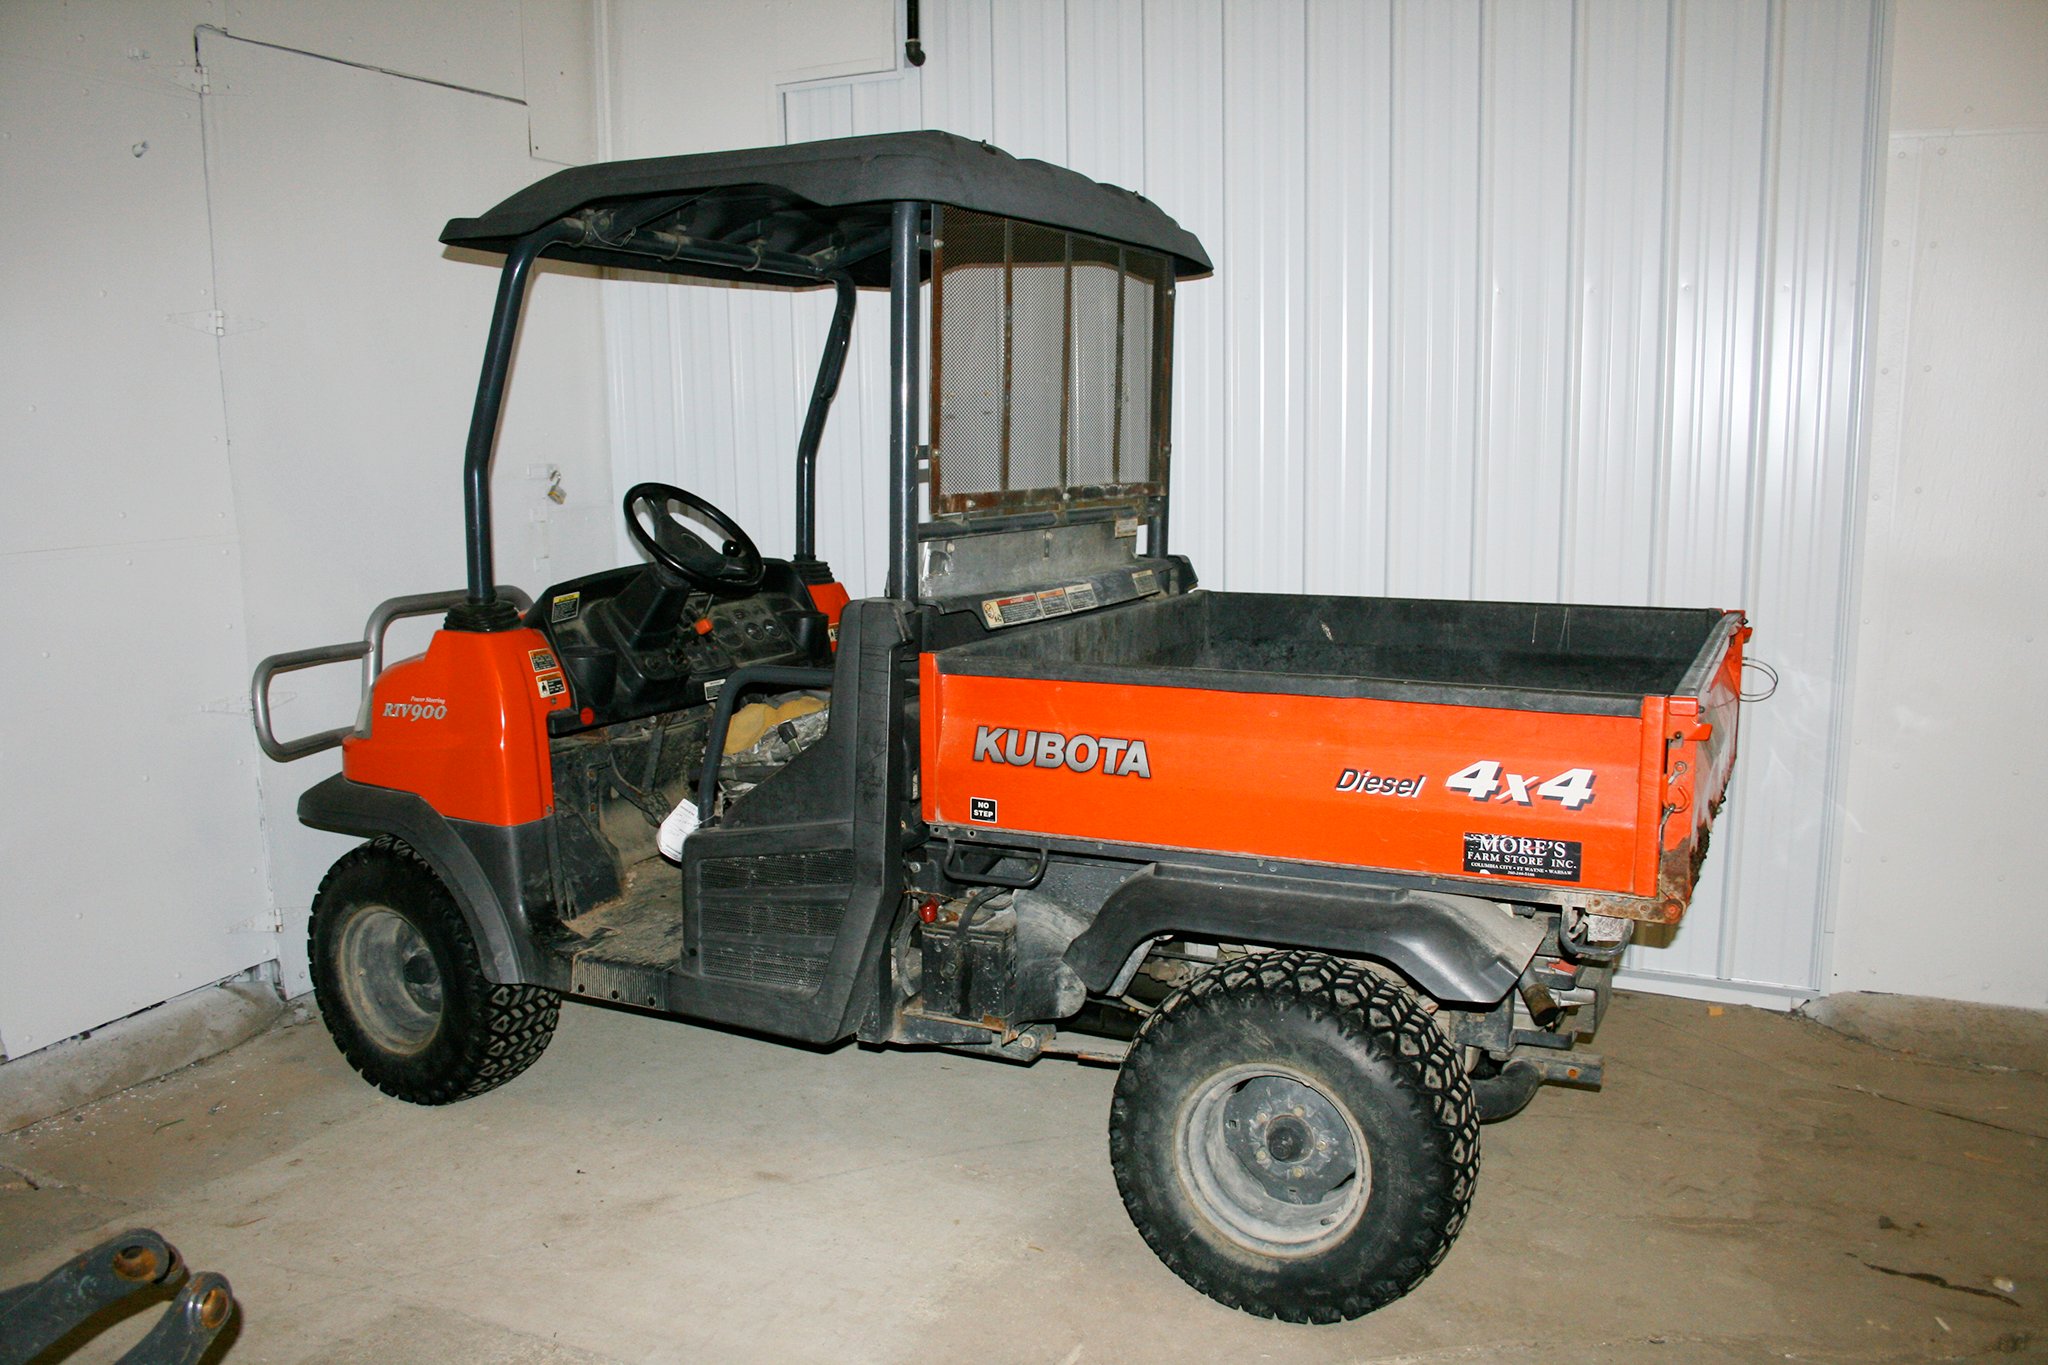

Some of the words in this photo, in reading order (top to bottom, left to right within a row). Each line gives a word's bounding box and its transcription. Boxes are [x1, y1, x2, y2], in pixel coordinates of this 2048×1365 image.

[382, 702, 448, 722] RTV900
[973, 725, 1151, 778] KUBOTA
[1336, 768, 1427, 798] Diesel
[1445, 759, 1597, 811] 4x4
[973, 809, 994, 818] STEP
[977, 801, 989, 809] NO
[1467, 851, 1500, 863] FARM
[1504, 854, 1544, 866] STORE
[1551, 859, 1577, 869] INC.
[1470, 861, 1499, 870] COLUMBIA
[1499, 863, 1513, 871] CITY
[1524, 865, 1545, 874] WAYNE
[1548, 868, 1573, 876] WARSAW
